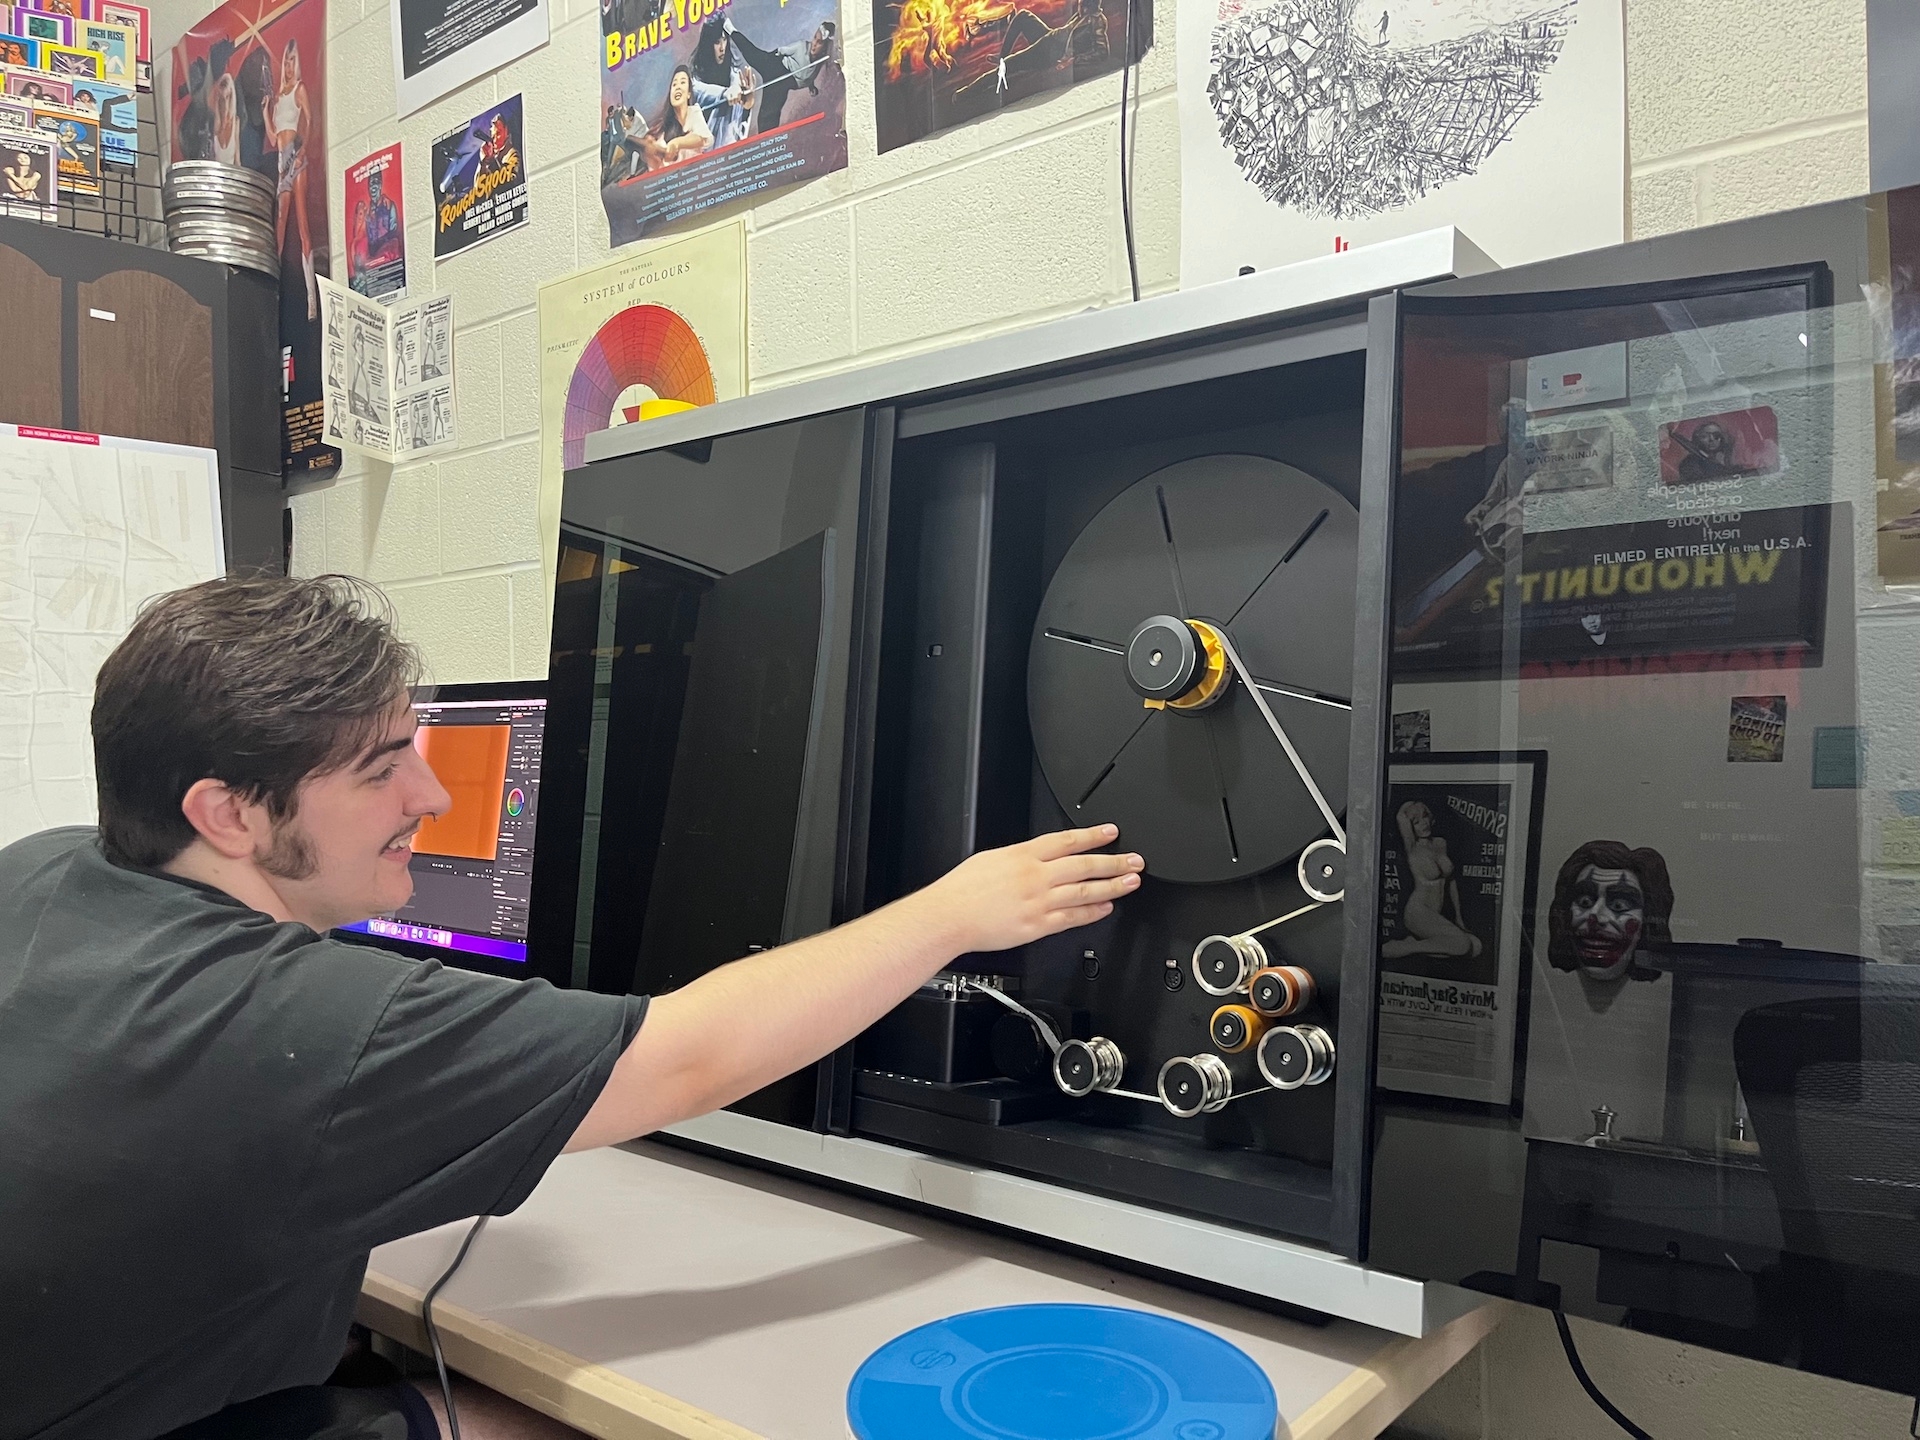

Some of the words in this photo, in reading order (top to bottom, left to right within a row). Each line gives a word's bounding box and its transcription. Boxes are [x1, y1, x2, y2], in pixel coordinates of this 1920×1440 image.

[87, 27, 106, 39] HIGH
[107, 30, 125, 42] RISE
[606, 12, 672, 69] BRAVE
[674, 0, 731, 31] YOU
[440, 187, 477, 233] ROUGH
[475, 165, 515, 199] SHOOT
[695, 201, 707, 210] KAM
[715, 191, 737, 203] MOTION
[737, 182, 758, 195] PICTURE
[619, 266, 630, 276] THE
[631, 261, 653, 272] NATURAL
[583, 282, 624, 304] SYSTEM
[628, 279, 636, 290] of
[639, 262, 691, 287] COLOURS
[627, 298, 642, 307] RED
[547, 338, 580, 354] PRISMATIC
[1568, 450, 1599, 460] NINJA
[1593, 549, 1646, 566] FILMED
[1654, 543, 1726, 559] ENTIRELY
[1730, 545, 1740, 553] in
[1743, 543, 1760, 553] the
[1763, 537, 1812, 550] U.S.A.
